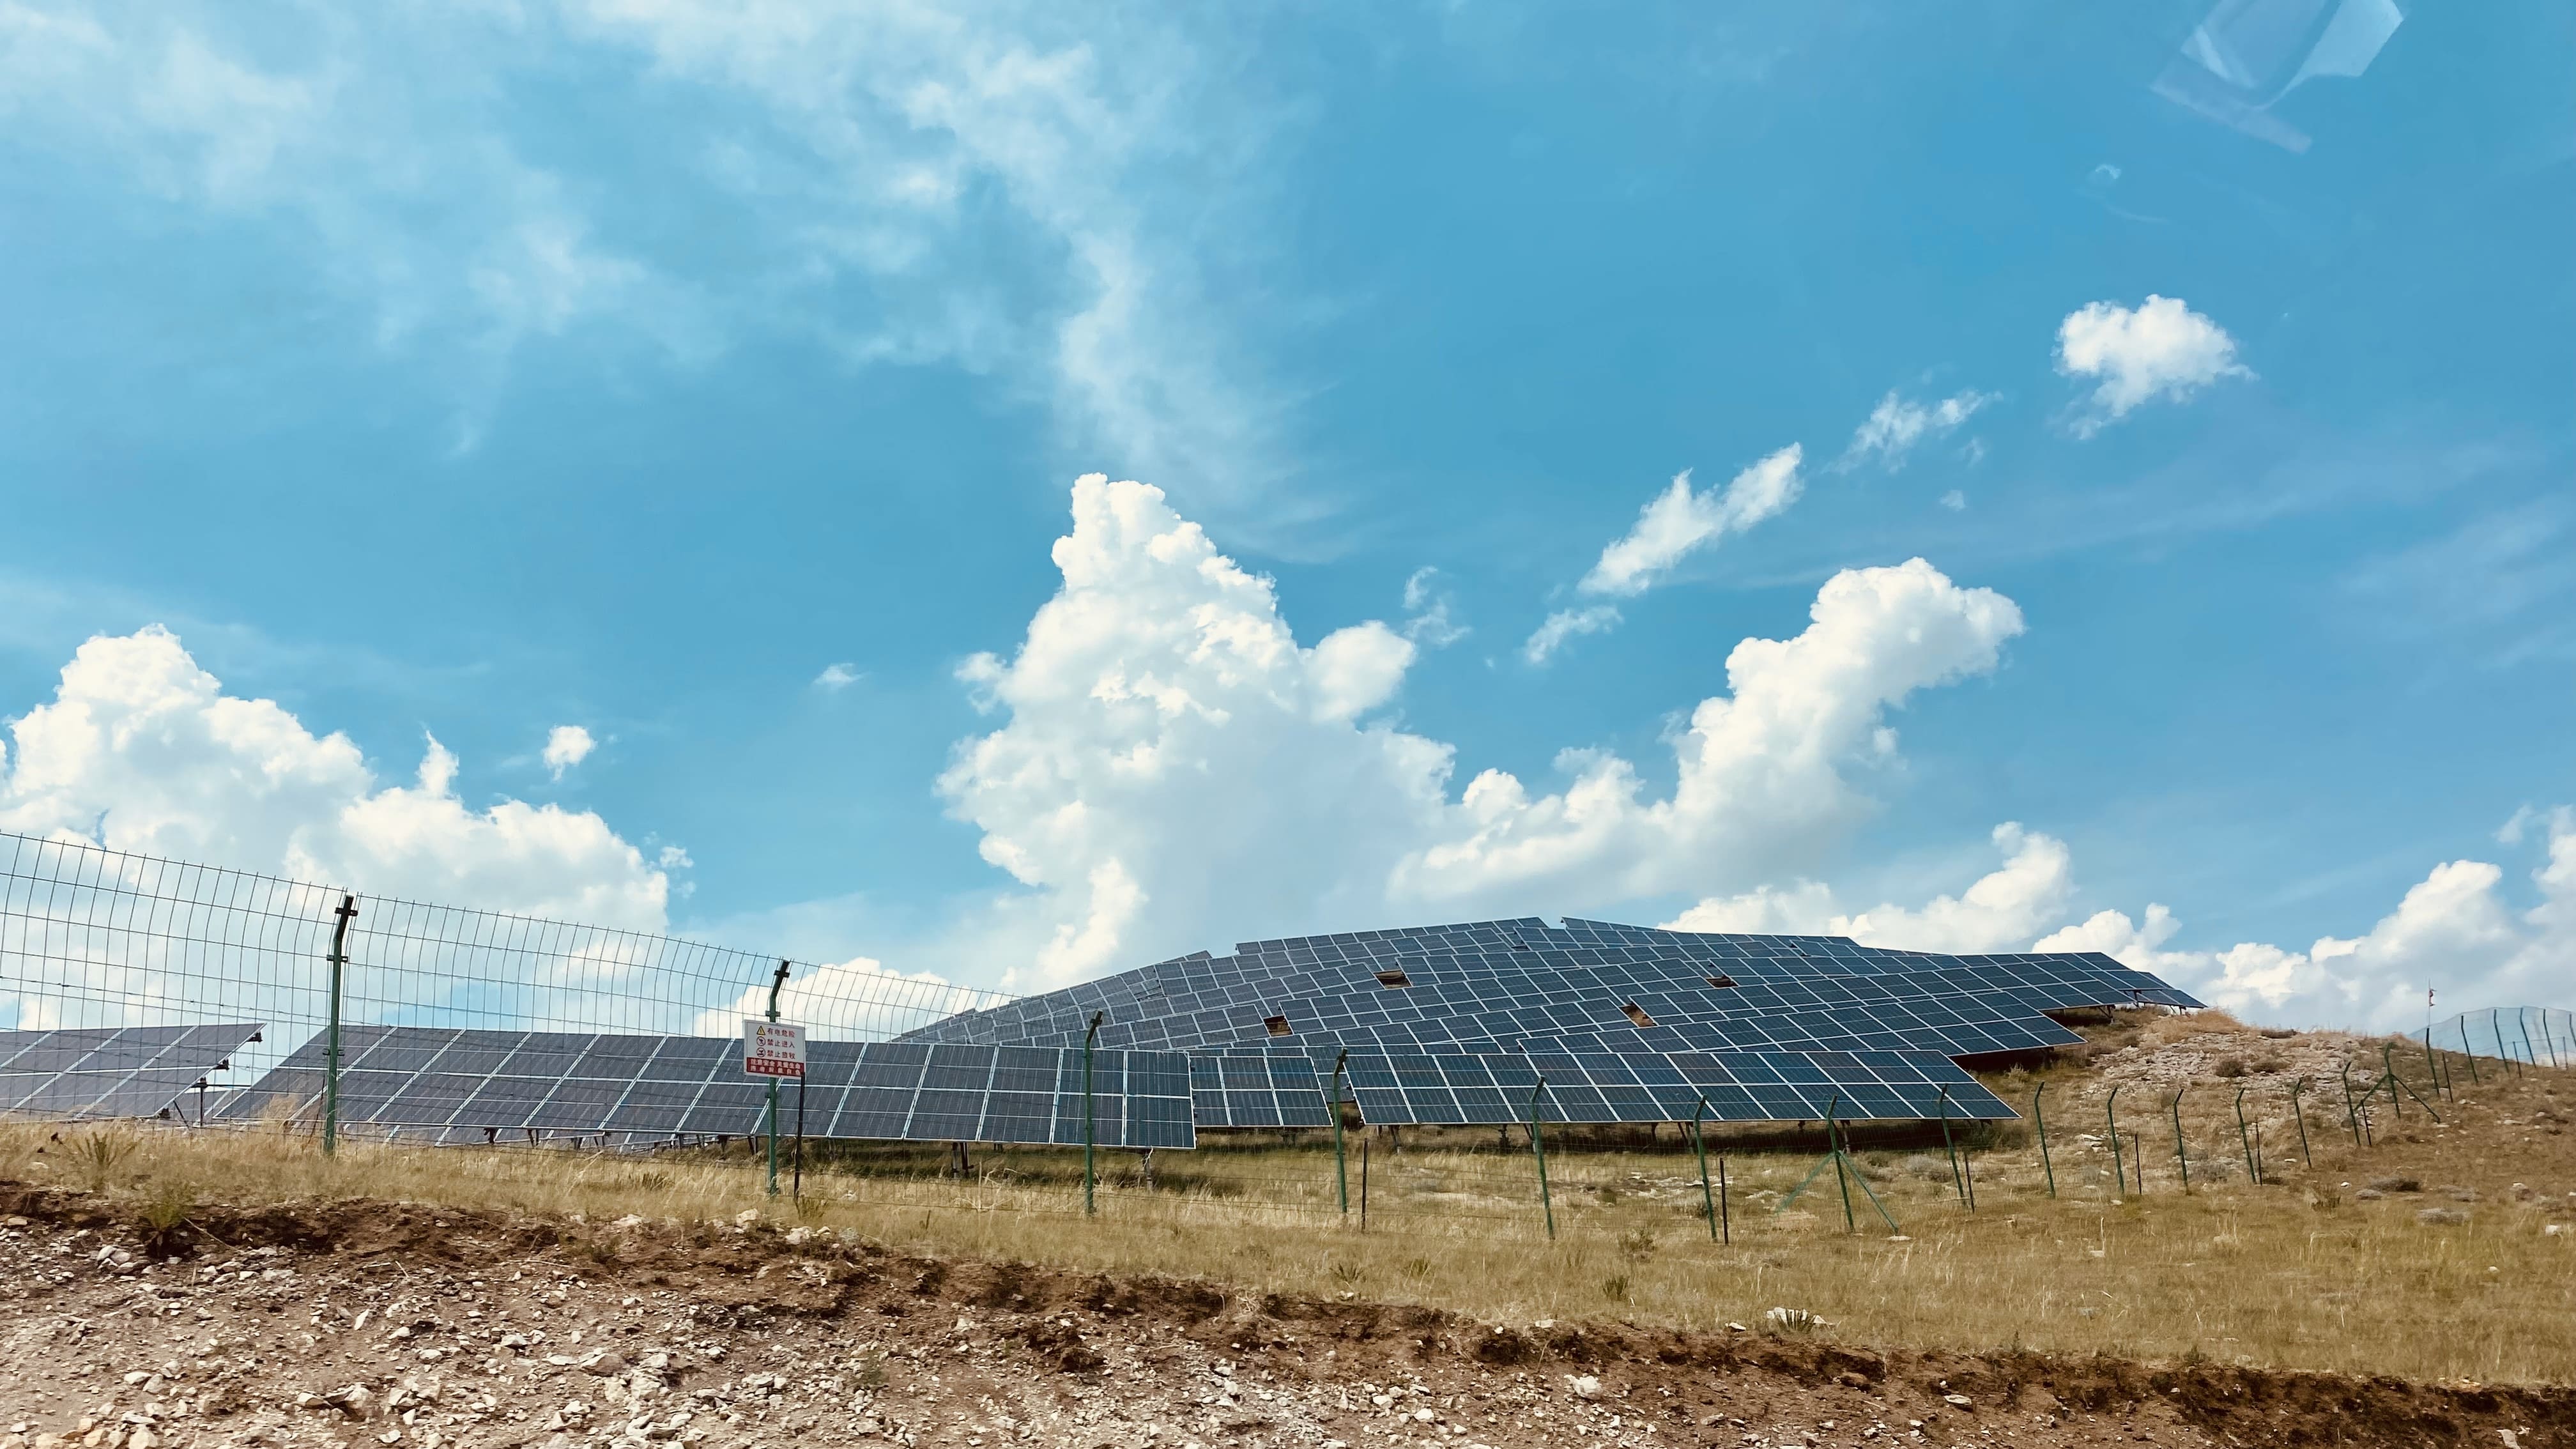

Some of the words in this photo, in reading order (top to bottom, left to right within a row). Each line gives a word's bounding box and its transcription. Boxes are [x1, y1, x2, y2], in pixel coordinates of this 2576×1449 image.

[767, 1028, 795, 1038] 有电危险
[767, 1039, 795, 1048] 禁止进入
